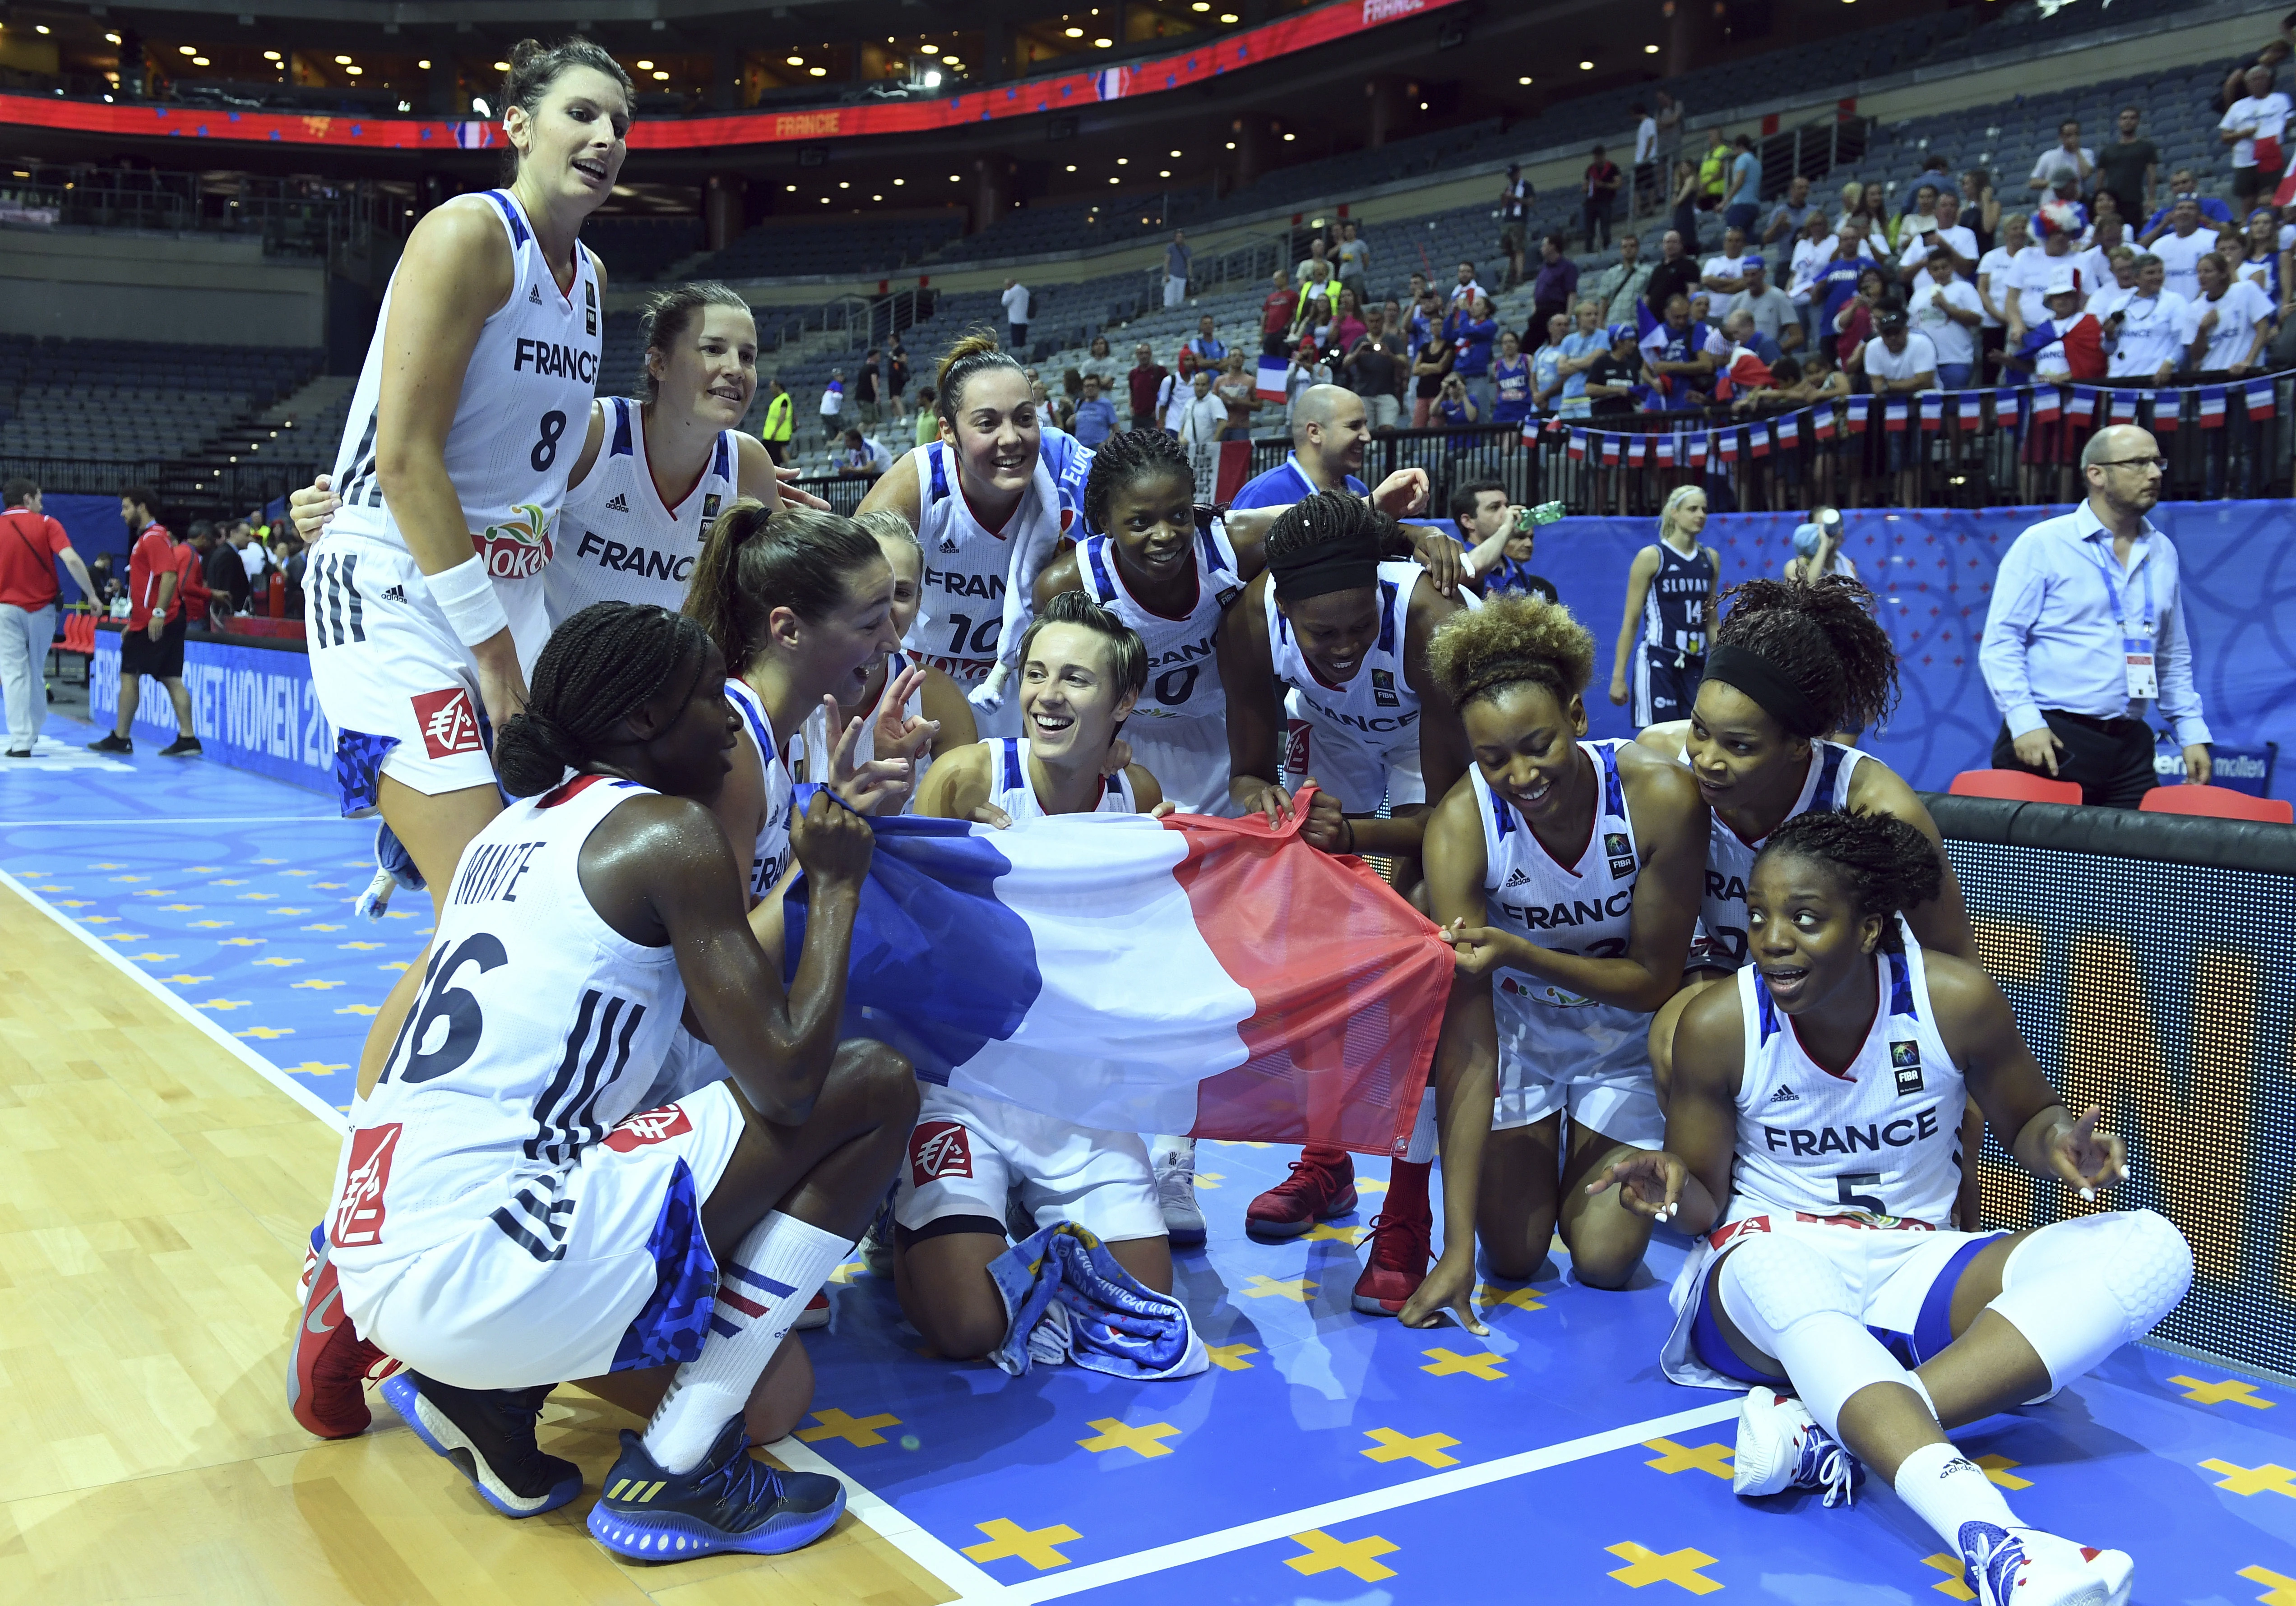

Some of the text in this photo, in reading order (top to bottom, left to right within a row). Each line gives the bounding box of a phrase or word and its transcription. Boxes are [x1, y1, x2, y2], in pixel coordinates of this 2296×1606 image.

[528, 295, 542, 306] adidas
[514, 337, 598, 386] FRANCE
[531, 410, 566, 472] 8
[1060, 445, 1092, 487] Euro
[605, 502, 629, 513] adidas
[576, 531, 696, 582] FRANC
[381, 593, 407, 605] adidas
[925, 566, 1008, 600] FRAN
[1684, 599, 1703, 624] 14
[949, 614, 1004, 654] 10
[1155, 664, 1199, 706] 0
[1378, 691, 1394, 699] FIBA
[226, 669, 299, 762] WOMEN
[454, 841, 547, 905] MINTE
[1505, 876, 1531, 888] adidas
[1613, 858, 1631, 869] FIBA
[1502, 884, 1635, 929] FRANC
[378, 932, 508, 1084] 16
[1898, 1070, 1918, 1083] FIBA
[1770, 1094, 1800, 1103] adidas
[1764, 1106, 1939, 1156] FRANCE
[1837, 1173, 1887, 1216] 5
